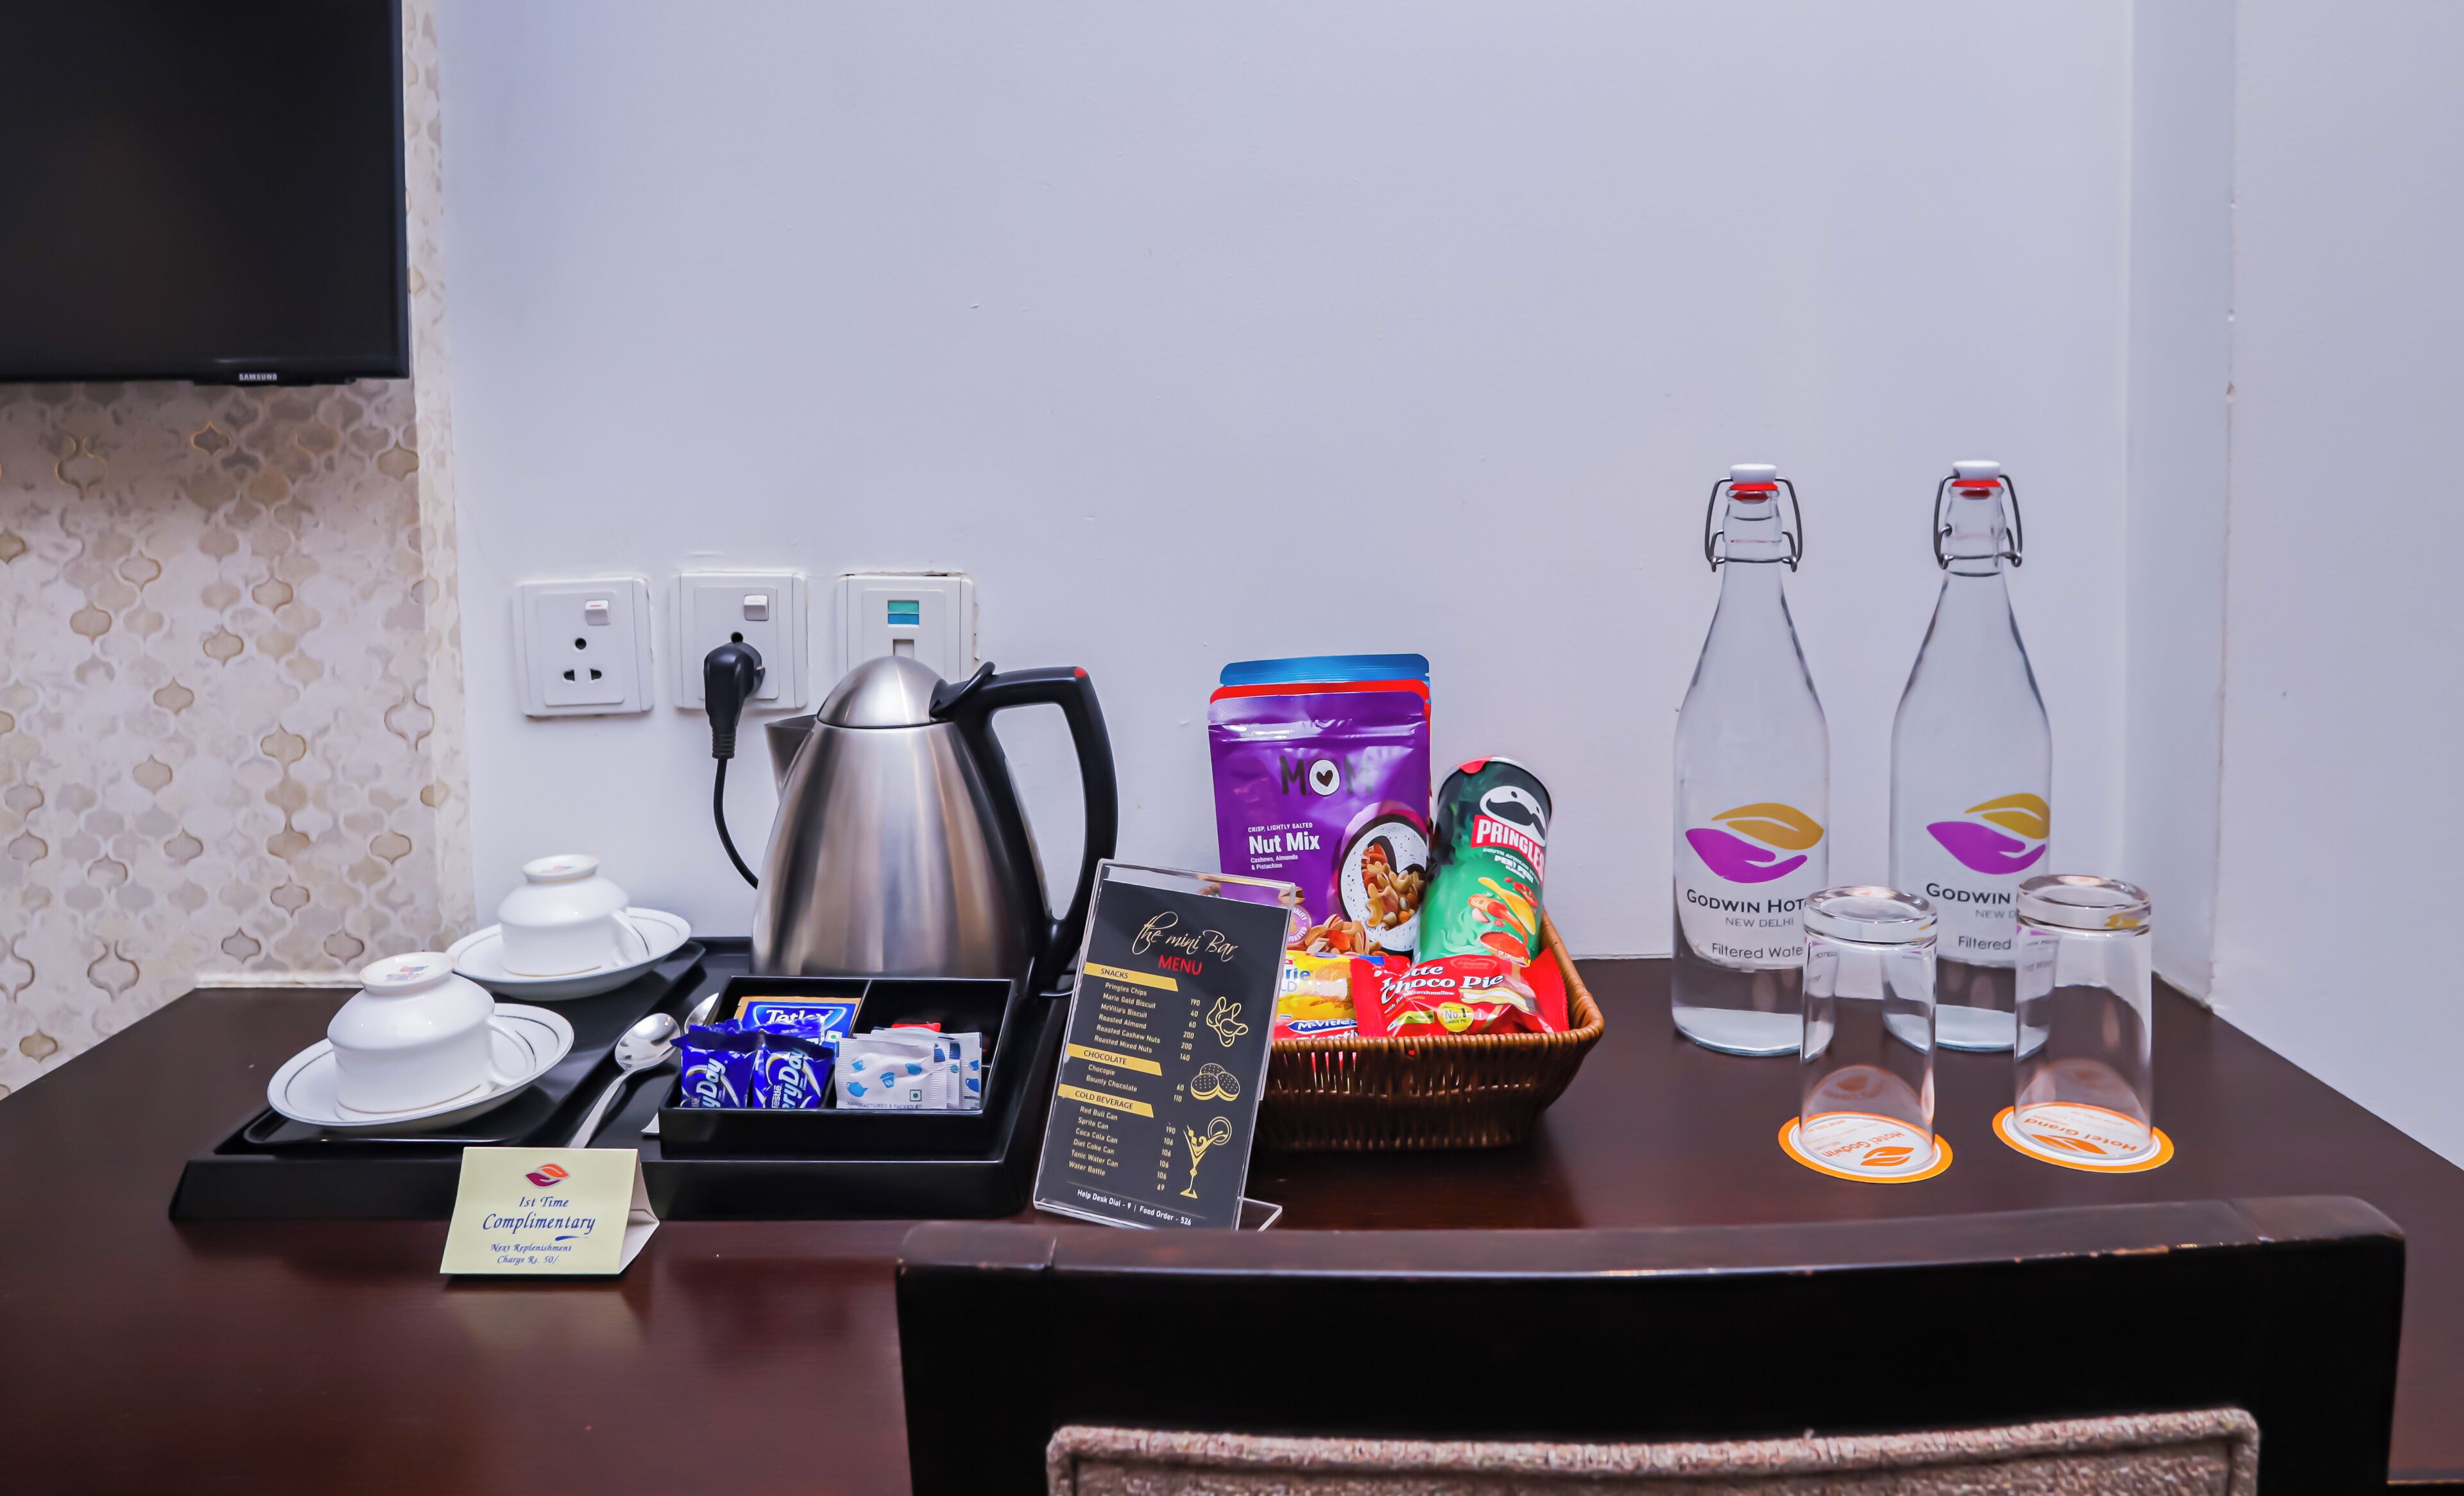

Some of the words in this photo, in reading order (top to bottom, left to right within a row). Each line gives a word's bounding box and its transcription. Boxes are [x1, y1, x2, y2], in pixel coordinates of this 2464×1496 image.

[1267, 823, 1290, 832] LIGHTLY
[1249, 835, 1282, 855] Nut
[1286, 831, 1321, 852] Mix
[1476, 819, 1544, 882] PRINGLES
[1687, 889, 1760, 913] GODWIN
[1768, 898, 1805, 914] HOT
[1926, 882, 2011, 904] GODWIN
[1725, 918, 1755, 927] NEW
[1759, 918, 1794, 928] DELHI
[1132, 911, 1178, 955] the
[1165, 933, 1202, 955] mini
[1202, 930, 1238, 962] Bar
[1958, 935, 2012, 950] Filtered
[1711, 942, 1763, 959] Filtered
[1768, 946, 1804, 958] Wate
[1100, 968, 1129, 979] SNACKS
[1158, 954, 1202, 976] MENU
[1286, 967, 1311, 980] rie
[1105, 982, 1129, 993] Pringles
[1131, 986, 1147, 995] Chips
[1381, 978, 1457, 1004] Choco
[1459, 975, 1504, 989] Pie
[1103, 993, 1120, 1001] Marie
[1121, 996, 1134, 1005] Gold
[1136, 999, 1156, 1009] Biscuit
[1127, 1008, 1147, 1018] Biscuit
[1445, 1008, 1467, 1020] No.1
[1099, 1014, 1122, 1024] Roasted
[1124, 1019, 1147, 1029] Almond
[1183, 1031, 1195, 1039] 200
[1094, 1035, 1118, 1046] Roasted
[1119, 1040, 1137, 1051] Mixed
[1138, 1044, 1152, 1053] Nuts
[1096, 1024, 1120, 1035] Roasted
[1122, 1029, 1145, 1040] Cashew
[1146, 1035, 1161, 1044] Nuts
[1181, 1042, 1192, 1051] 200
[1083, 1049, 1127, 1065] CHOCOLATE
[1088, 1064, 1116, 1076] Chocopie
[1086, 1075, 1107, 1087] Bounty
[1108, 1079, 1138, 1092] Chocolate
[1075, 1090, 1095, 1101] COLD
[1097, 1096, 1134, 1110] BEVERAGE
[1080, 1106, 1091, 1114] Red
[1093, 1109, 1105, 1118] Bull
[1106, 1112, 1118, 1121] Can
[1166, 1126, 1176, 1134] 190
[2023, 1118, 2079, 1137] Grand
[1078, 1117, 1096, 1127] Sprite
[1097, 1121, 1109, 1130] Can
[1164, 1137, 1174, 1146] 106
[1870, 1131, 1904, 1145] Hotel
[1075, 1128, 1090, 1137] Coca
[1091, 1131, 1105, 1141] Cola
[1106, 1135, 1118, 1144] Can
[1161, 1149, 1171, 1157] 106
[1821, 1140, 1871, 1158] Godwin
[2084, 1134, 2137, 1152] Hotel
[1074, 1139, 1085, 1148] Diet
[1087, 1142, 1101, 1152] Coke
[1103, 1146, 1115, 1155] Can
[1159, 1160, 1169, 1169] 106
[1068, 1160, 1086, 1171] Water
[1088, 1165, 1106, 1176] Bottle
[1071, 1149, 1086, 1160] Tonic
[1088, 1153, 1105, 1164] Water
[1107, 1159, 1118, 1167] Can
[1157, 1171, 1167, 1180] 106
[540, 1196, 569, 1208] Time
[1077, 1189, 1091, 1200] Help
[1092, 1194, 1108, 1203] Desk
[1109, 1197, 1121, 1207] Dial
[1139, 1206, 1155, 1216] Food
[1156, 1210, 1174, 1221] Order
[1180, 1216, 1192, 1226] 526
[483, 1211, 595, 1234] Complimentary
[490, 1242, 510, 1252] Next
[513, 1242, 572, 1253] Replenishment
[497, 1255, 525, 1266] Charge
